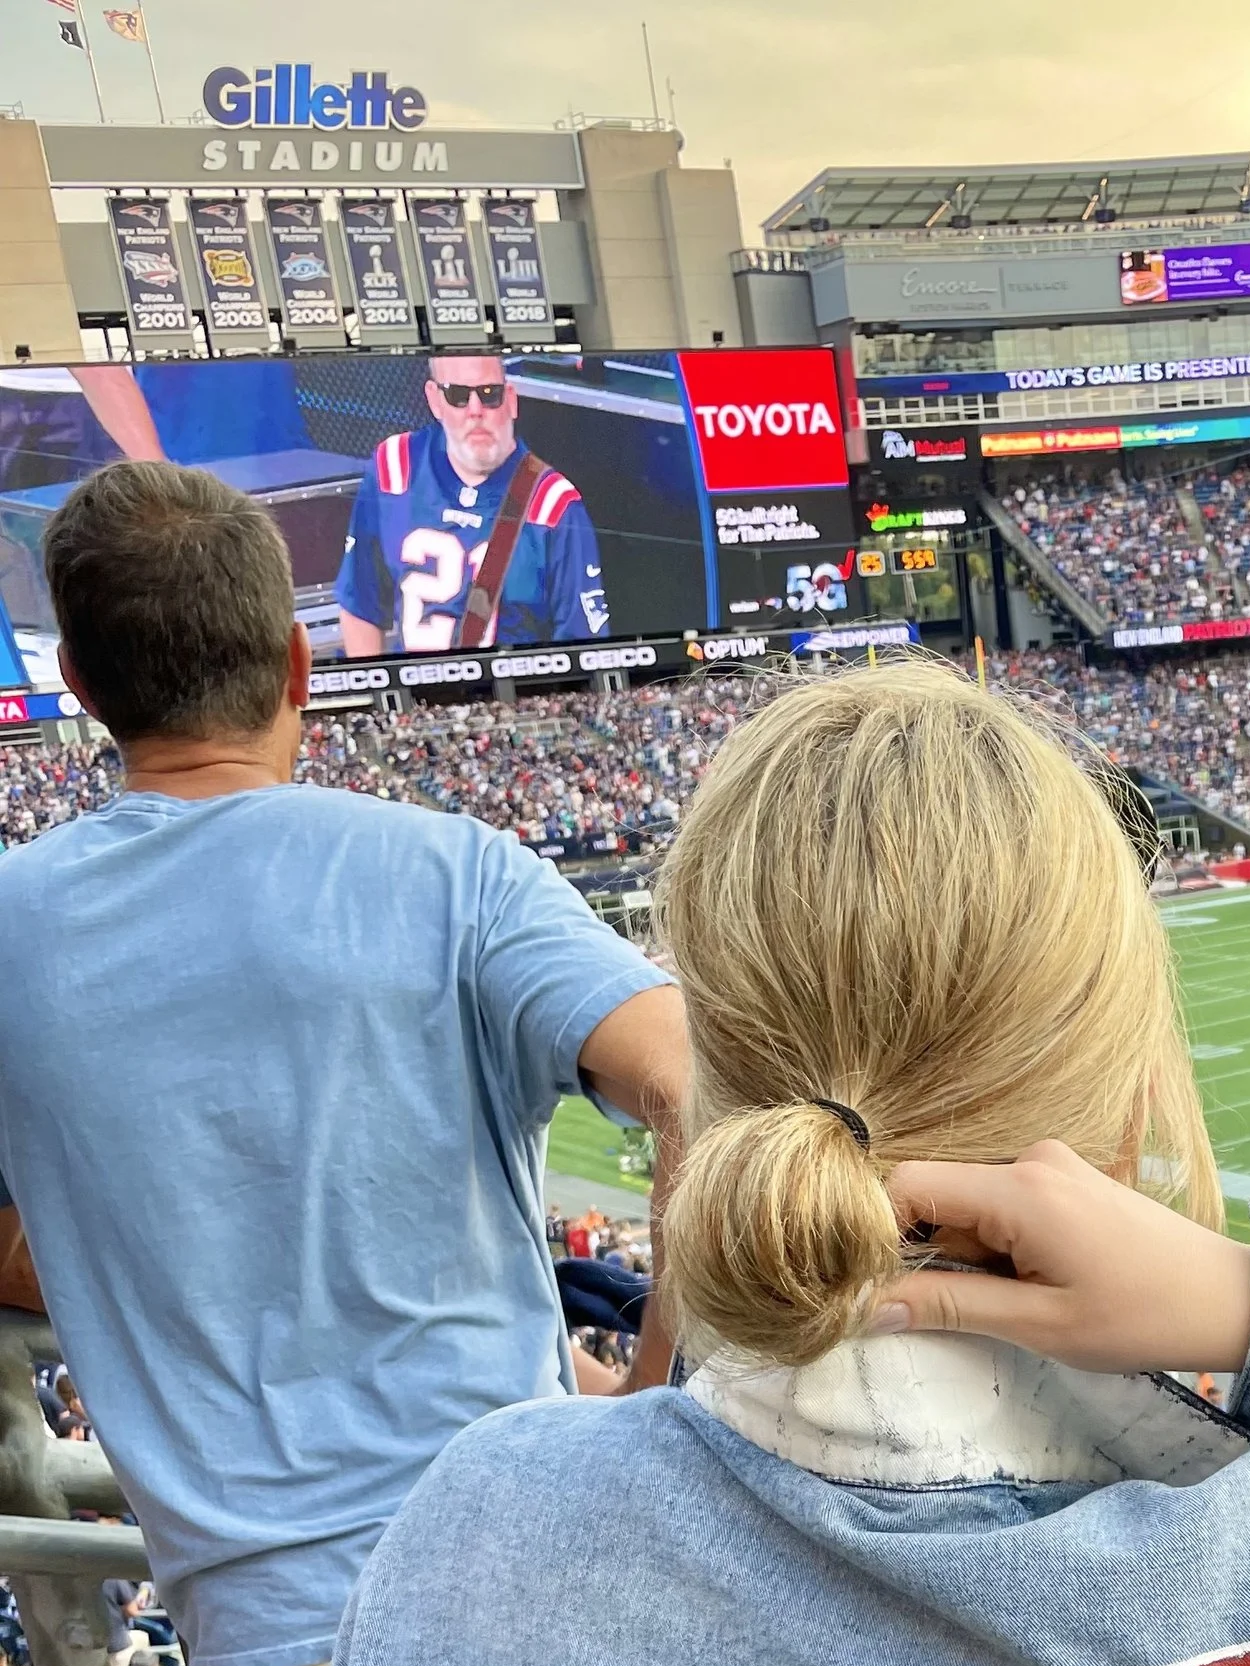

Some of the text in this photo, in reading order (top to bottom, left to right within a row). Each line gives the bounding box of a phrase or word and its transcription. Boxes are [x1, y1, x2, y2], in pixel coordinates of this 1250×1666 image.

[202, 63, 428, 130] Gillette
[202, 139, 449, 172] STADIUM
[901, 268, 998, 297] Encore
[138, 313, 186, 328] 2001
[213, 311, 264, 326] 2003
[289, 309, 338, 324] 2004
[365, 308, 408, 323] 2014
[436, 307, 479, 323] 2016
[504, 306, 546, 321] 2018
[1005, 366, 1087, 390] TODAY'S
[1087, 362, 1142, 386] GAME
[1143, 362, 1163, 382] IS
[694, 402, 837, 439] TOYOTA
[704, 637, 766, 659] OPTUM
[308, 646, 658, 694] GEICO GEICO GEICO GEICO
